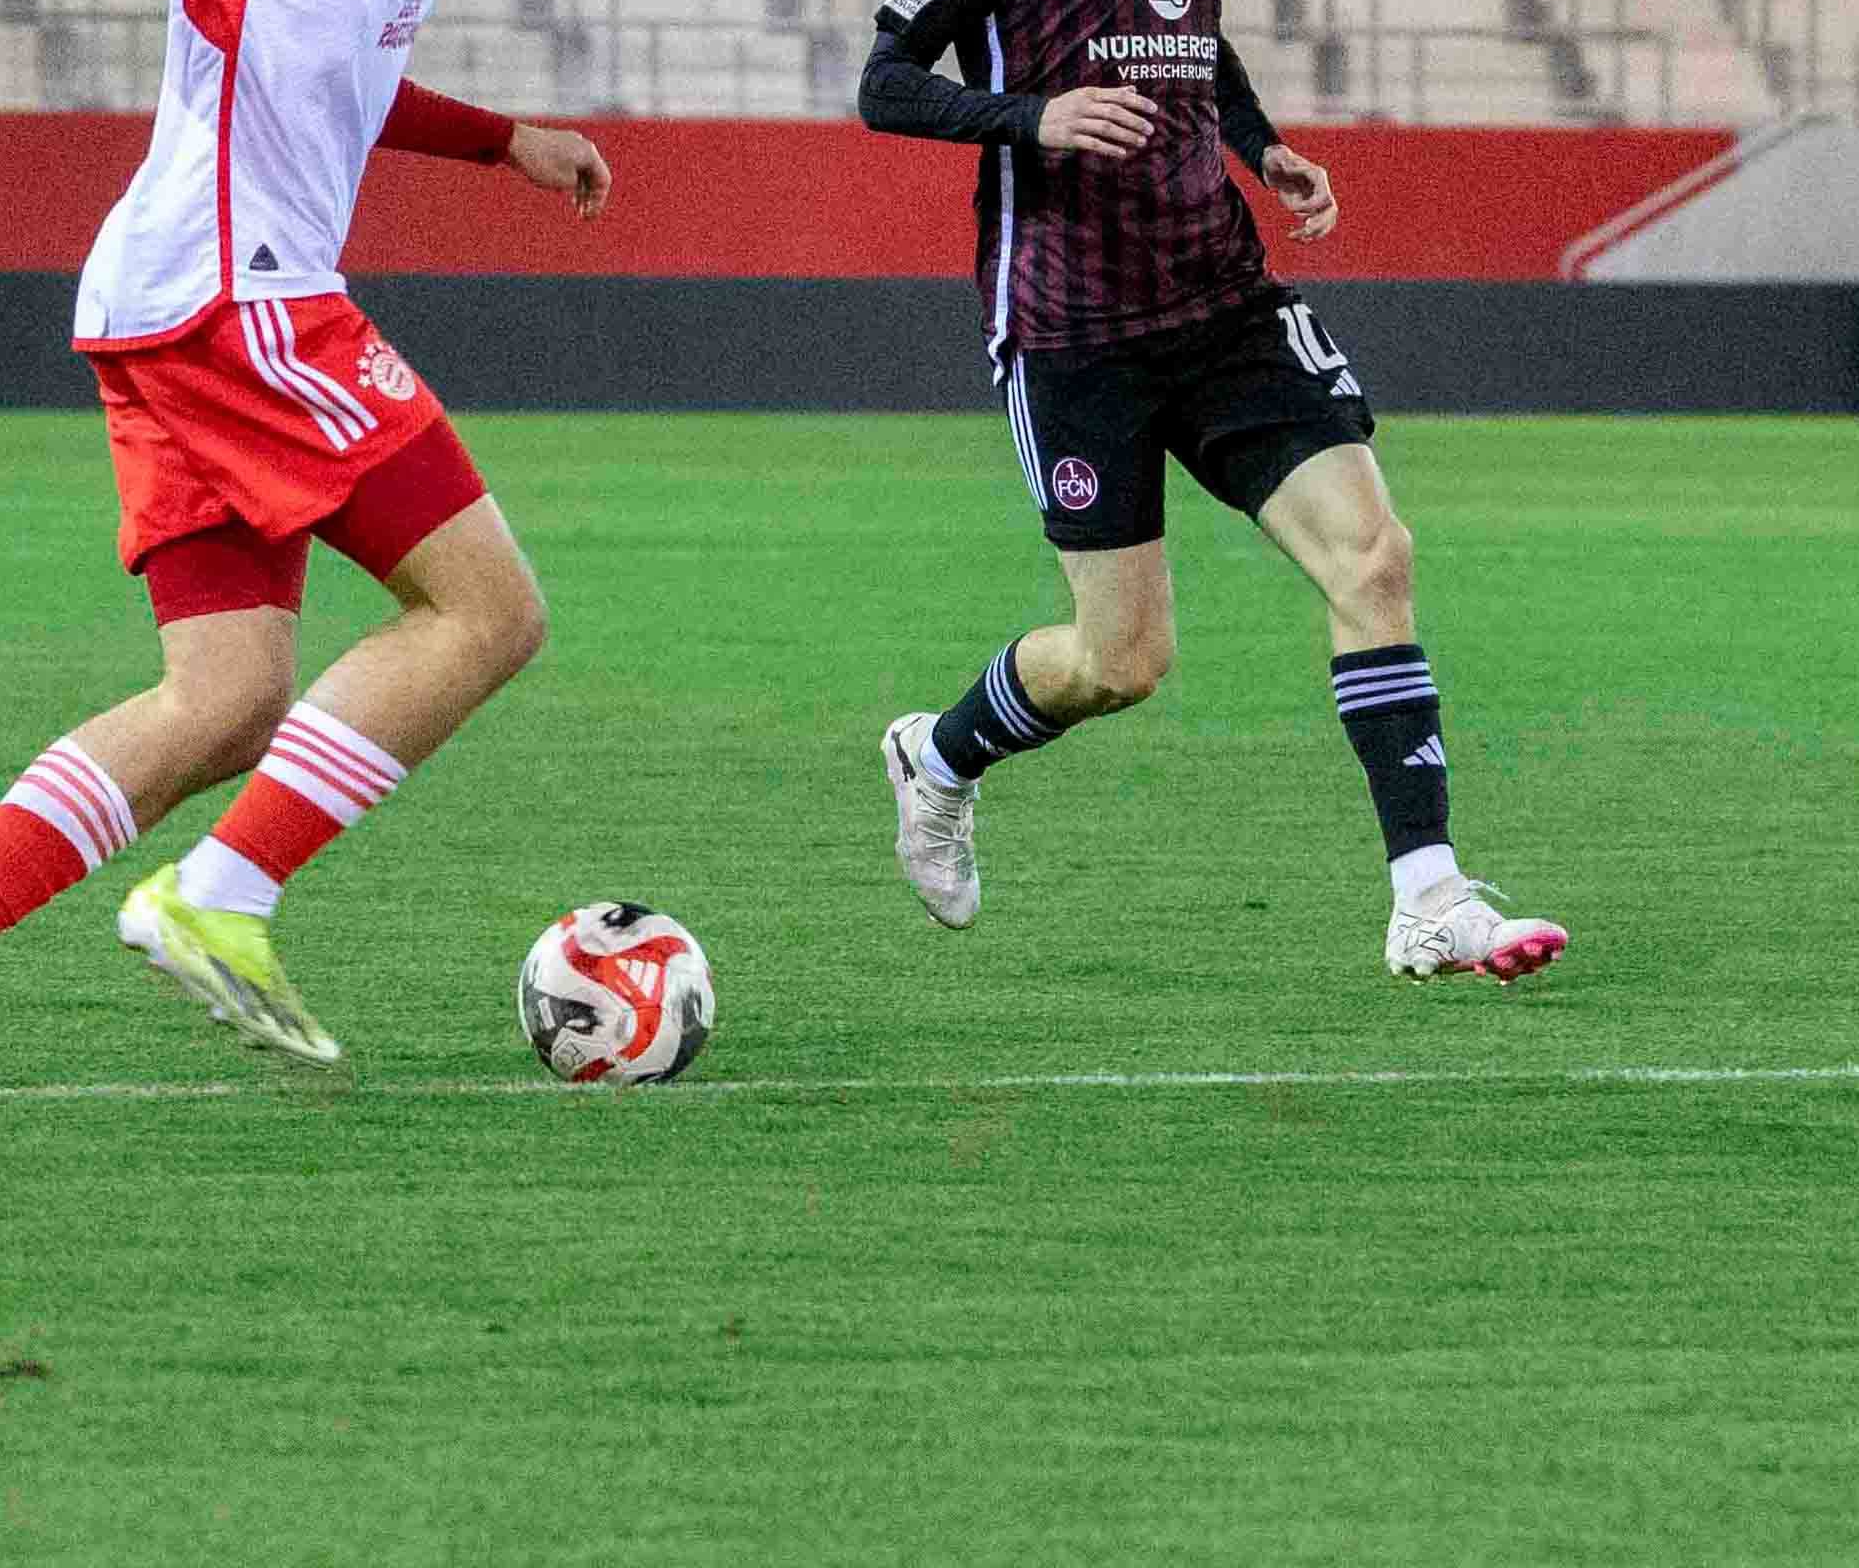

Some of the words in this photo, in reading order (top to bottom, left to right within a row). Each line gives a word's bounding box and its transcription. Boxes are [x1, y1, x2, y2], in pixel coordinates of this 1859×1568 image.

[1117, 63, 1215, 81] VERSICHERUNG
[1276, 303, 1348, 375] 10
[1057, 477, 1093, 498] FCN
